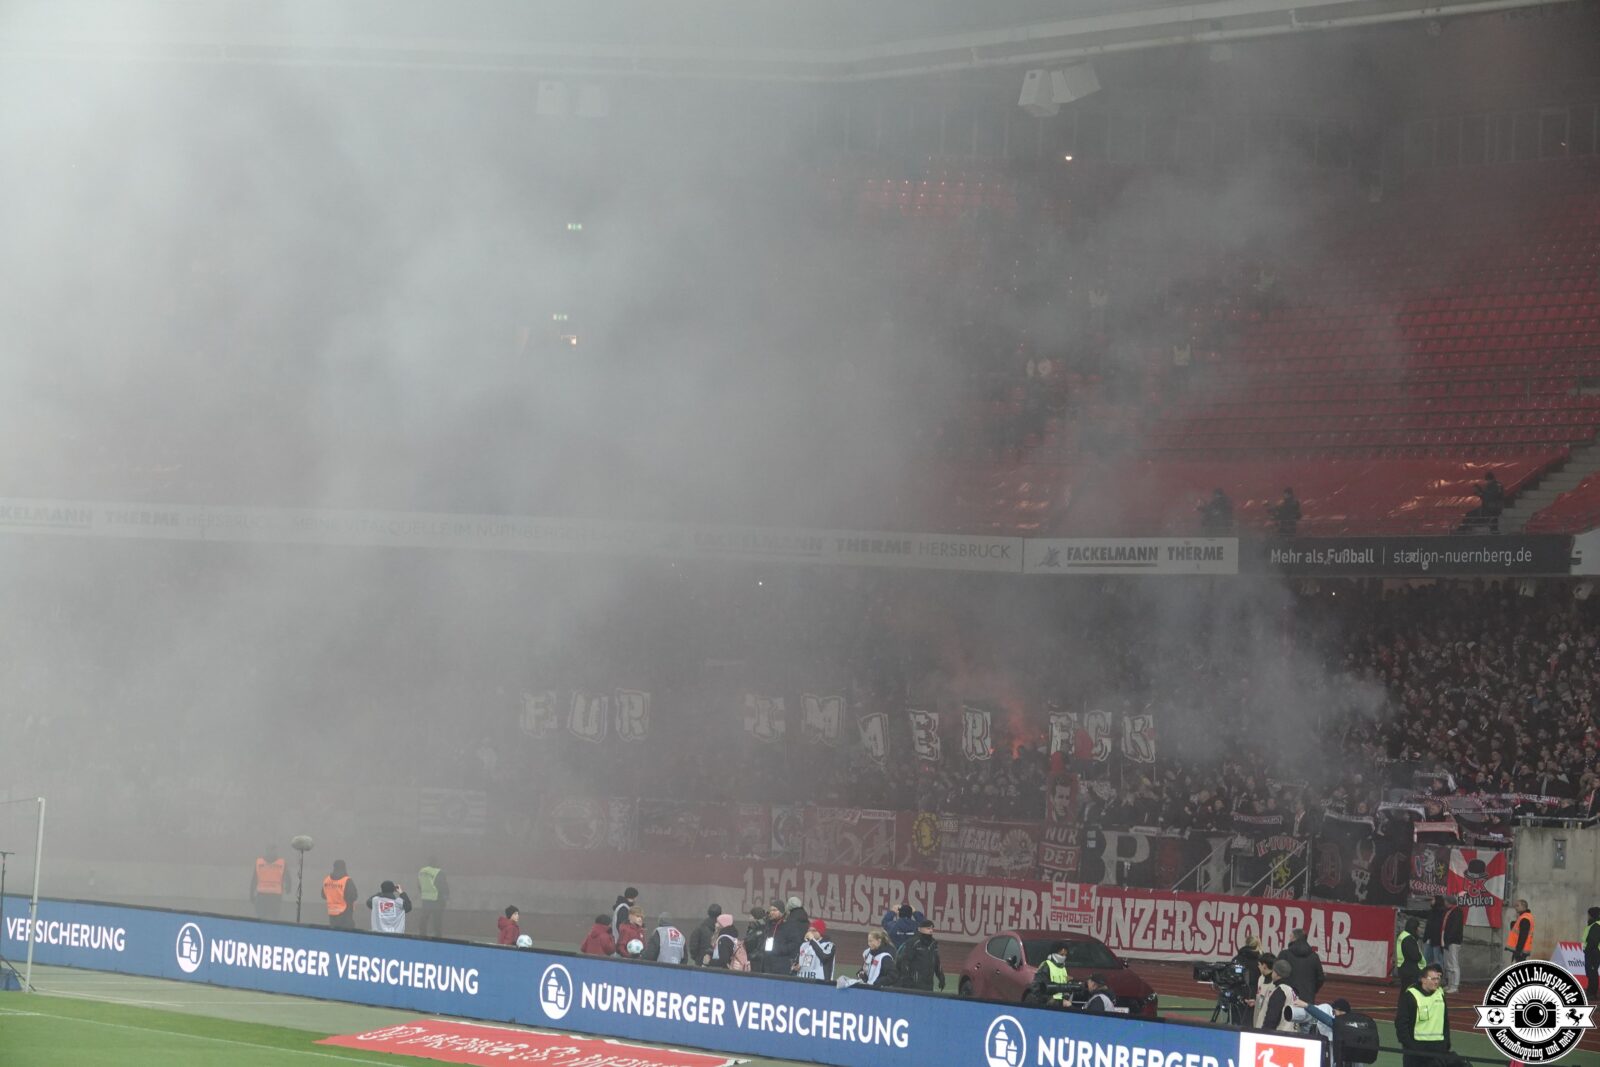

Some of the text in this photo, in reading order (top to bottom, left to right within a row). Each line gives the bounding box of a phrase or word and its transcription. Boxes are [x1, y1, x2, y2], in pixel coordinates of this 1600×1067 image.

[836, 538, 911, 555] THERME
[919, 541, 1012, 560] HERSBRUCK
[1066, 545, 1224, 561] FACKELMANN THERME
[1270, 548, 1302, 564] Mehr
[1327, 547, 1374, 564] Fußball
[1393, 546, 1532, 566] stadion-nuernberg.de
[1043, 848, 1076, 865] DER
[1051, 882, 1097, 910] 50+1
[210, 938, 480, 996] NÜRNBERGER VERSICHERUNG
[580, 980, 909, 1049] NÜRNBERGER VERSICHERUNG
